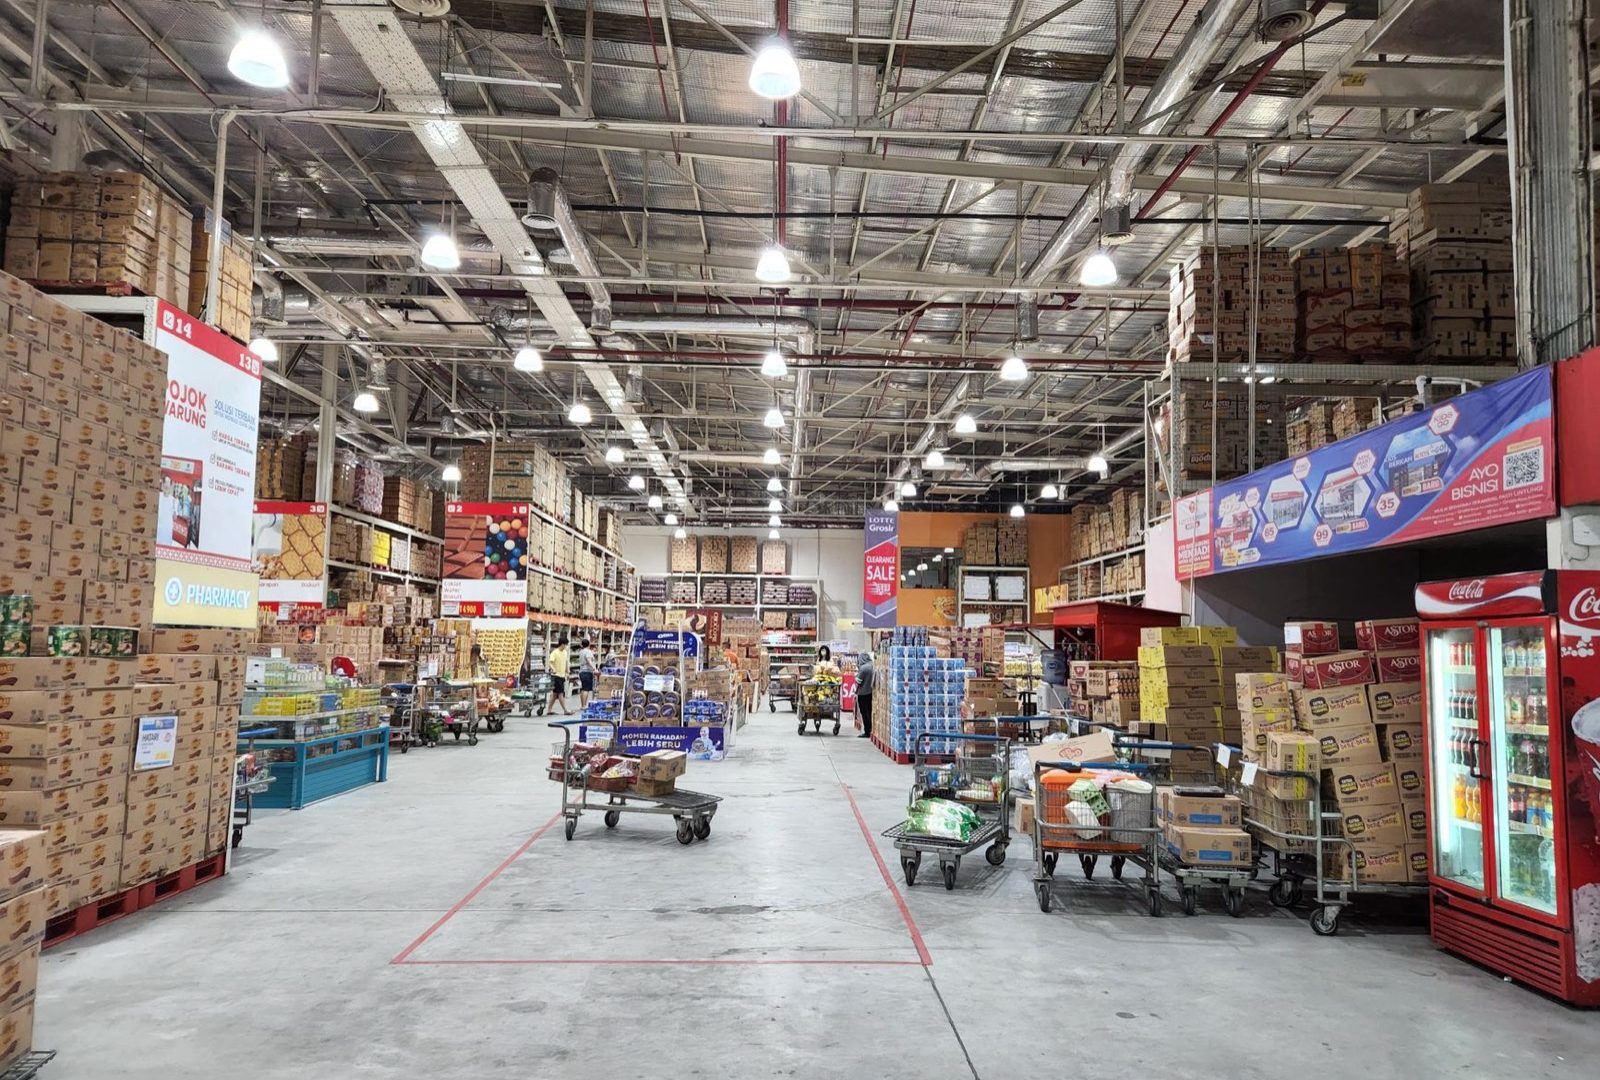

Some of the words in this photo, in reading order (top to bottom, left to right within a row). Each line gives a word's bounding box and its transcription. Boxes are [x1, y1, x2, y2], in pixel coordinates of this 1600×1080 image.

[176, 318, 192, 339] 14
[239, 353, 252, 371] 13
[166, 380, 206, 413] OJOK
[1469, 463, 1498, 481] AYO
[1451, 479, 1498, 501] BISNIS!
[309, 505, 317, 513] 3
[456, 505, 463, 513] 2
[1379, 498, 1395, 511] 35
[869, 524, 895, 532] Grosir
[1315, 529, 1329, 540] 99
[866, 556, 896, 564] CLEARANCE
[866, 565, 896, 581] SALE
[186, 584, 250, 610] PHARMACY
[1384, 624, 1418, 636] ASTOR
[1328, 660, 1361, 673] ASTOR
[1390, 656, 1420, 669] ASTO
[626, 740, 654, 748] LEBIH
[656, 740, 681, 748] SERU
